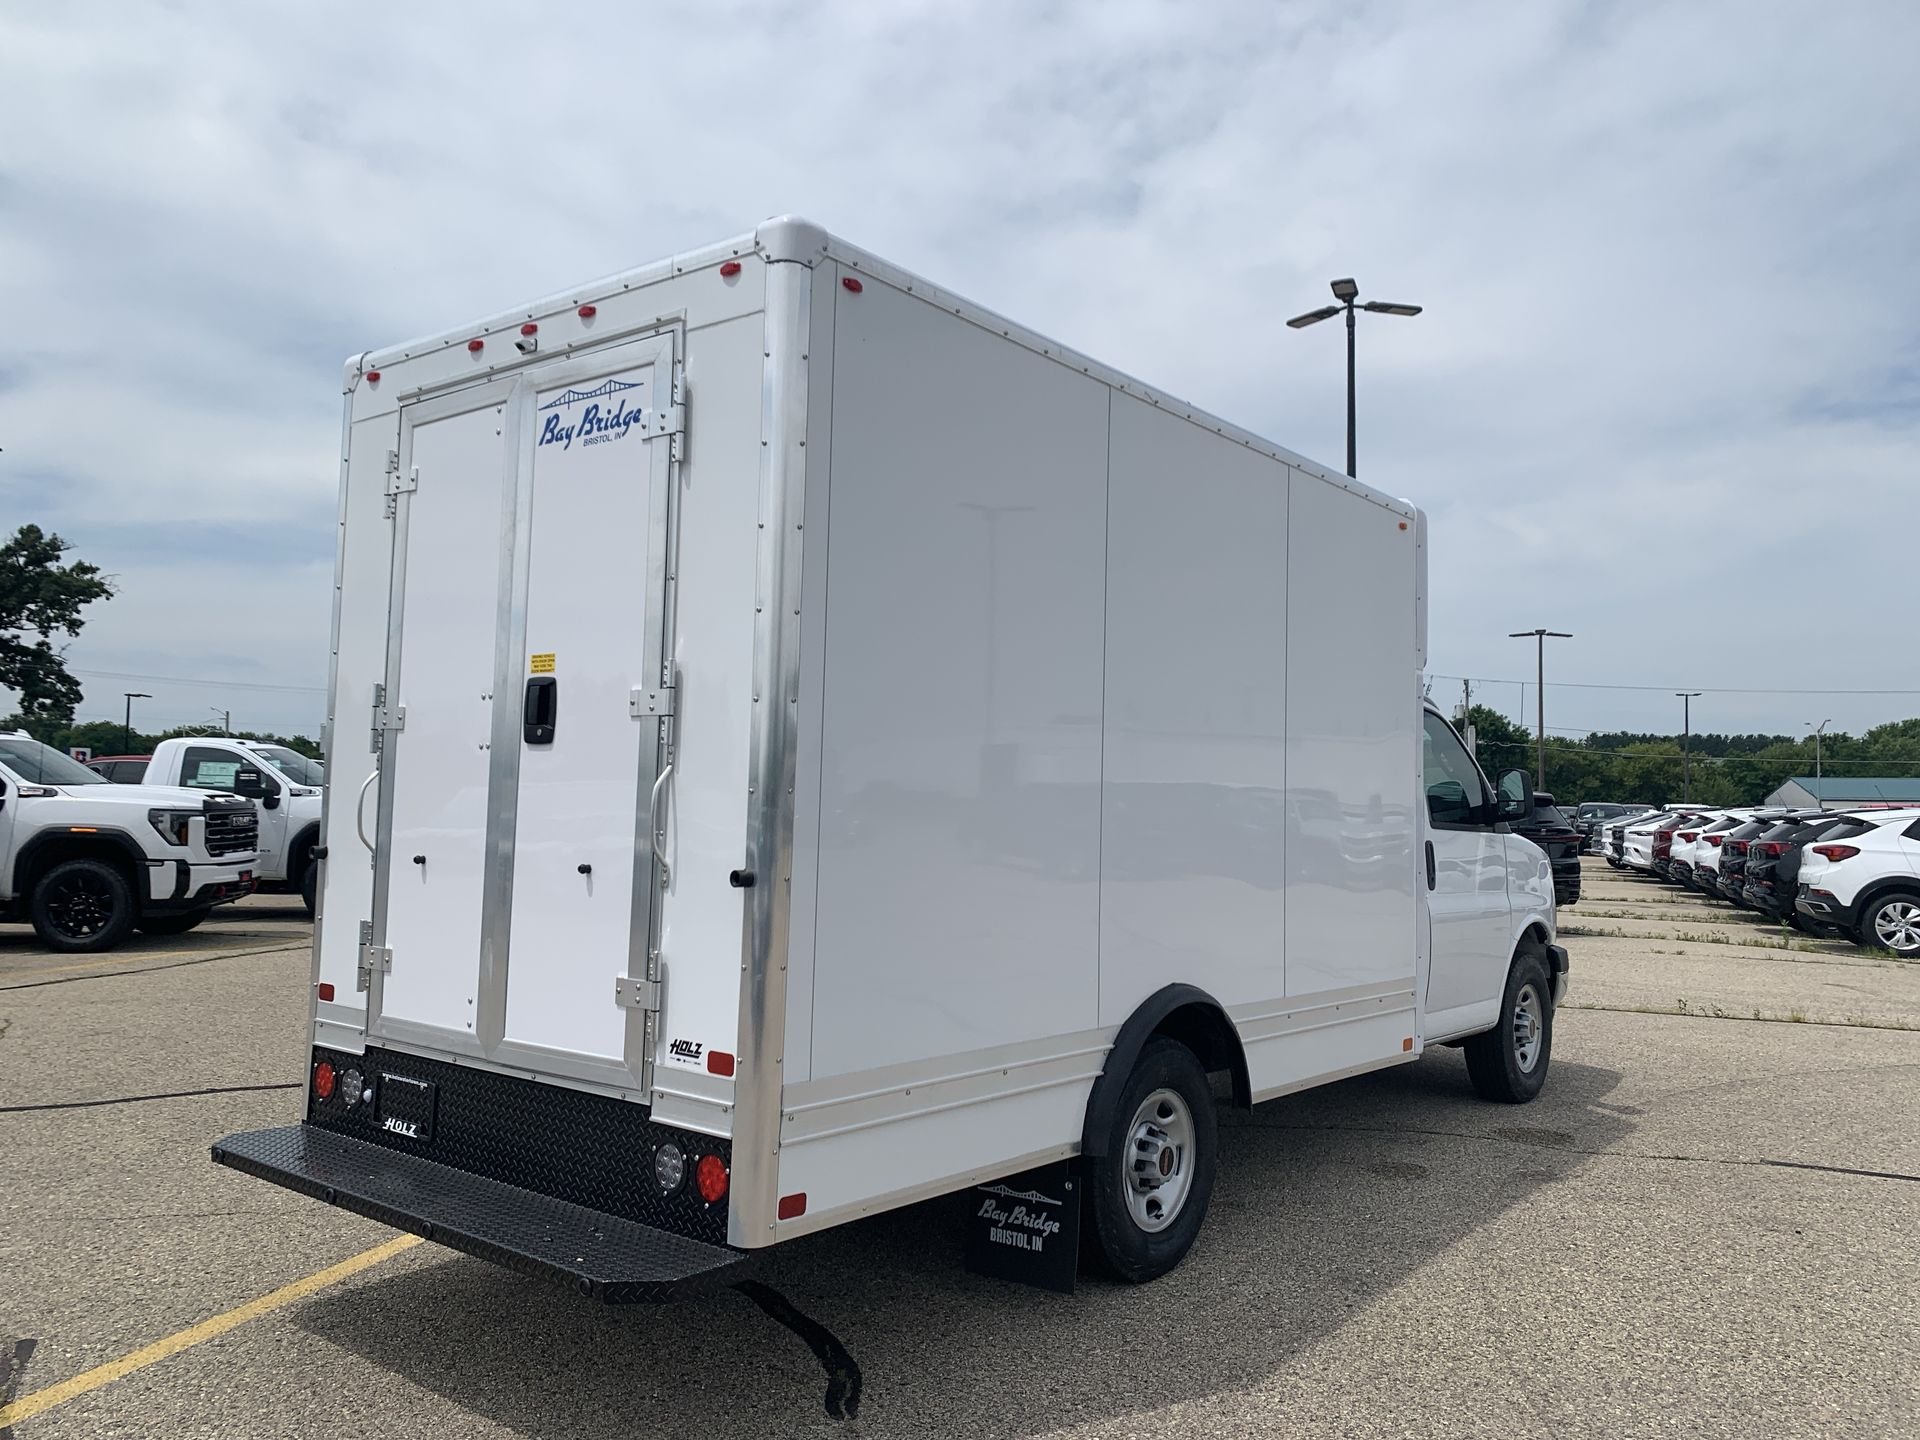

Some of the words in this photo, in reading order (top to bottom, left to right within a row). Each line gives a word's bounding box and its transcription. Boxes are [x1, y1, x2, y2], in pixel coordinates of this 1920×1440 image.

[538, 413, 575, 450] Bay
[576, 399, 642, 437] Bridge
[583, 433, 613, 447] BRISTOL,
[614, 432, 622, 440] IN
[669, 1039, 703, 1058] HOLZ
[383, 1117, 417, 1138] HOLZ
[977, 1199, 1008, 1227] Bay
[1008, 1206, 1060, 1237] Bridge
[990, 1226, 1030, 1250] BRISTOL,
[1032, 1236, 1043, 1252] IN
